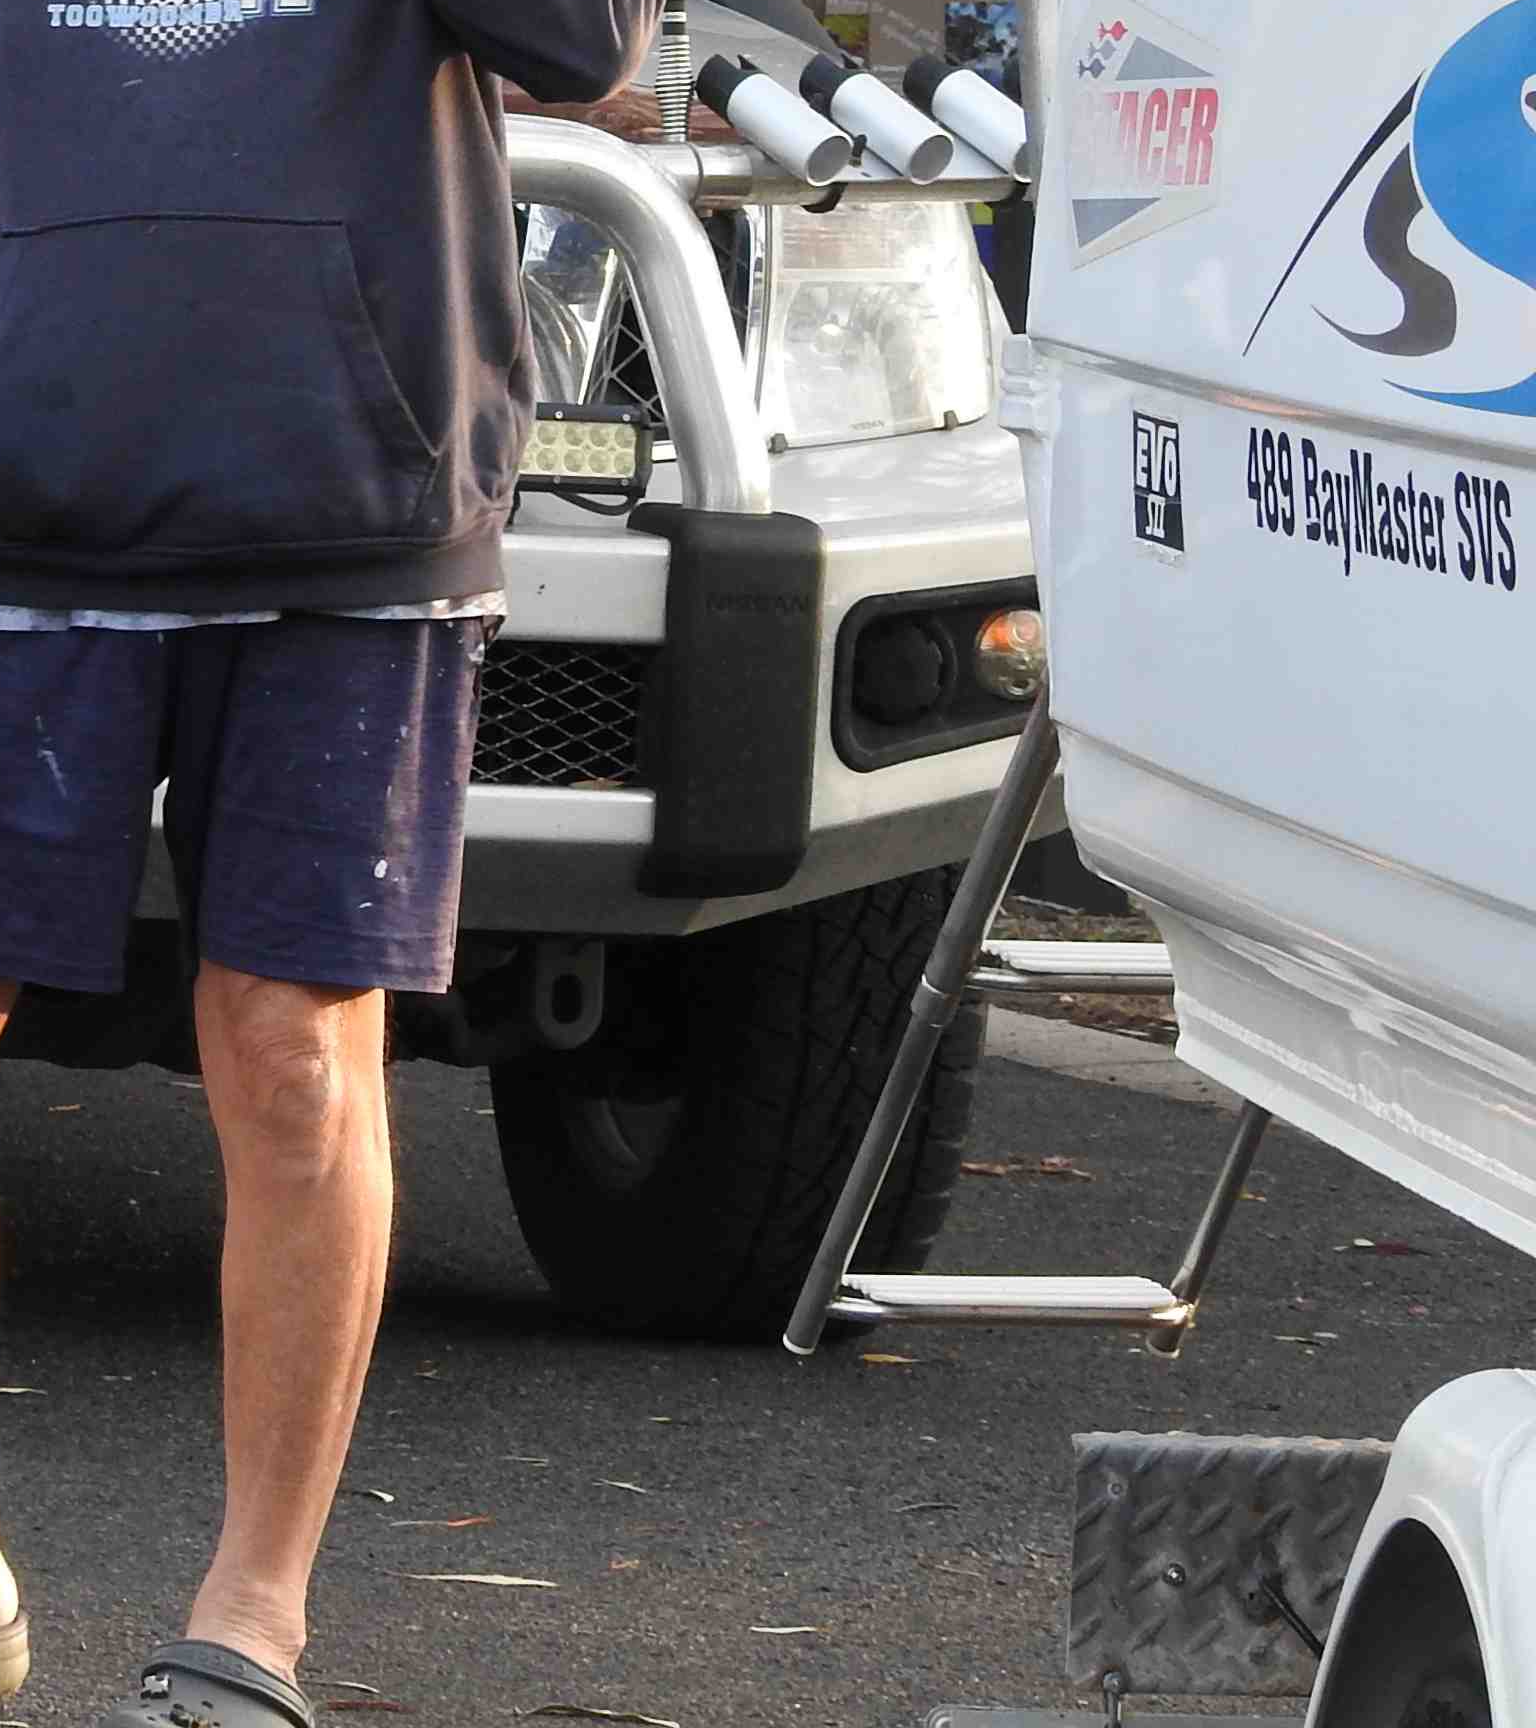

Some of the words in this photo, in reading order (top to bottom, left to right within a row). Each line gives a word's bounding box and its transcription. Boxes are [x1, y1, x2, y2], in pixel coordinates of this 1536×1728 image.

[1078, 87, 1220, 186] TACER
[1136, 418, 1177, 497] EVO
[1247, 427, 1295, 537] 489
[1301, 438, 1447, 576] BayMaster
[1454, 471, 1516, 592] SVS
